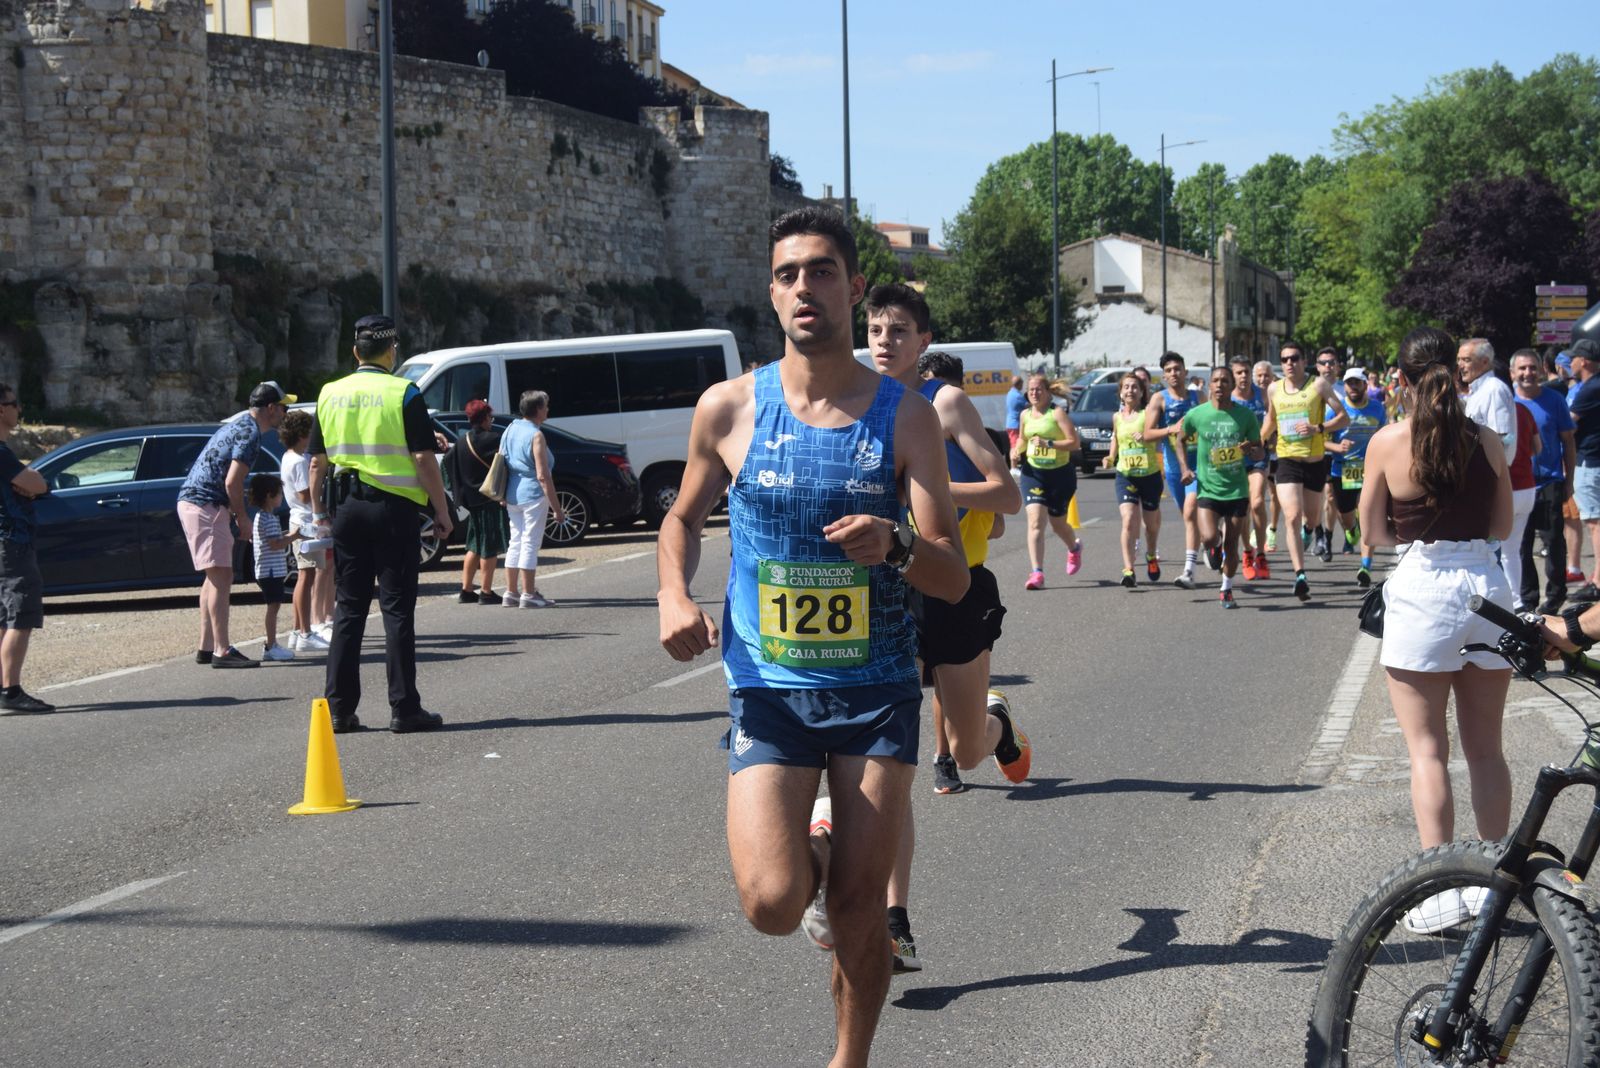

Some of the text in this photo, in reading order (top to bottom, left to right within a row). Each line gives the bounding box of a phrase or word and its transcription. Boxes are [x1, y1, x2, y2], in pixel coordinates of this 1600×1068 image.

[1219, 448, 1236, 461] 32
[1125, 456, 1143, 468] 102
[789, 567, 855, 577] FUNDACION
[789, 577, 854, 586] CAJA RURAL
[771, 593, 852, 634] 128
[787, 647, 862, 659] CAJA RURAL
[1346, 859, 1445, 941] SCHWALBE
